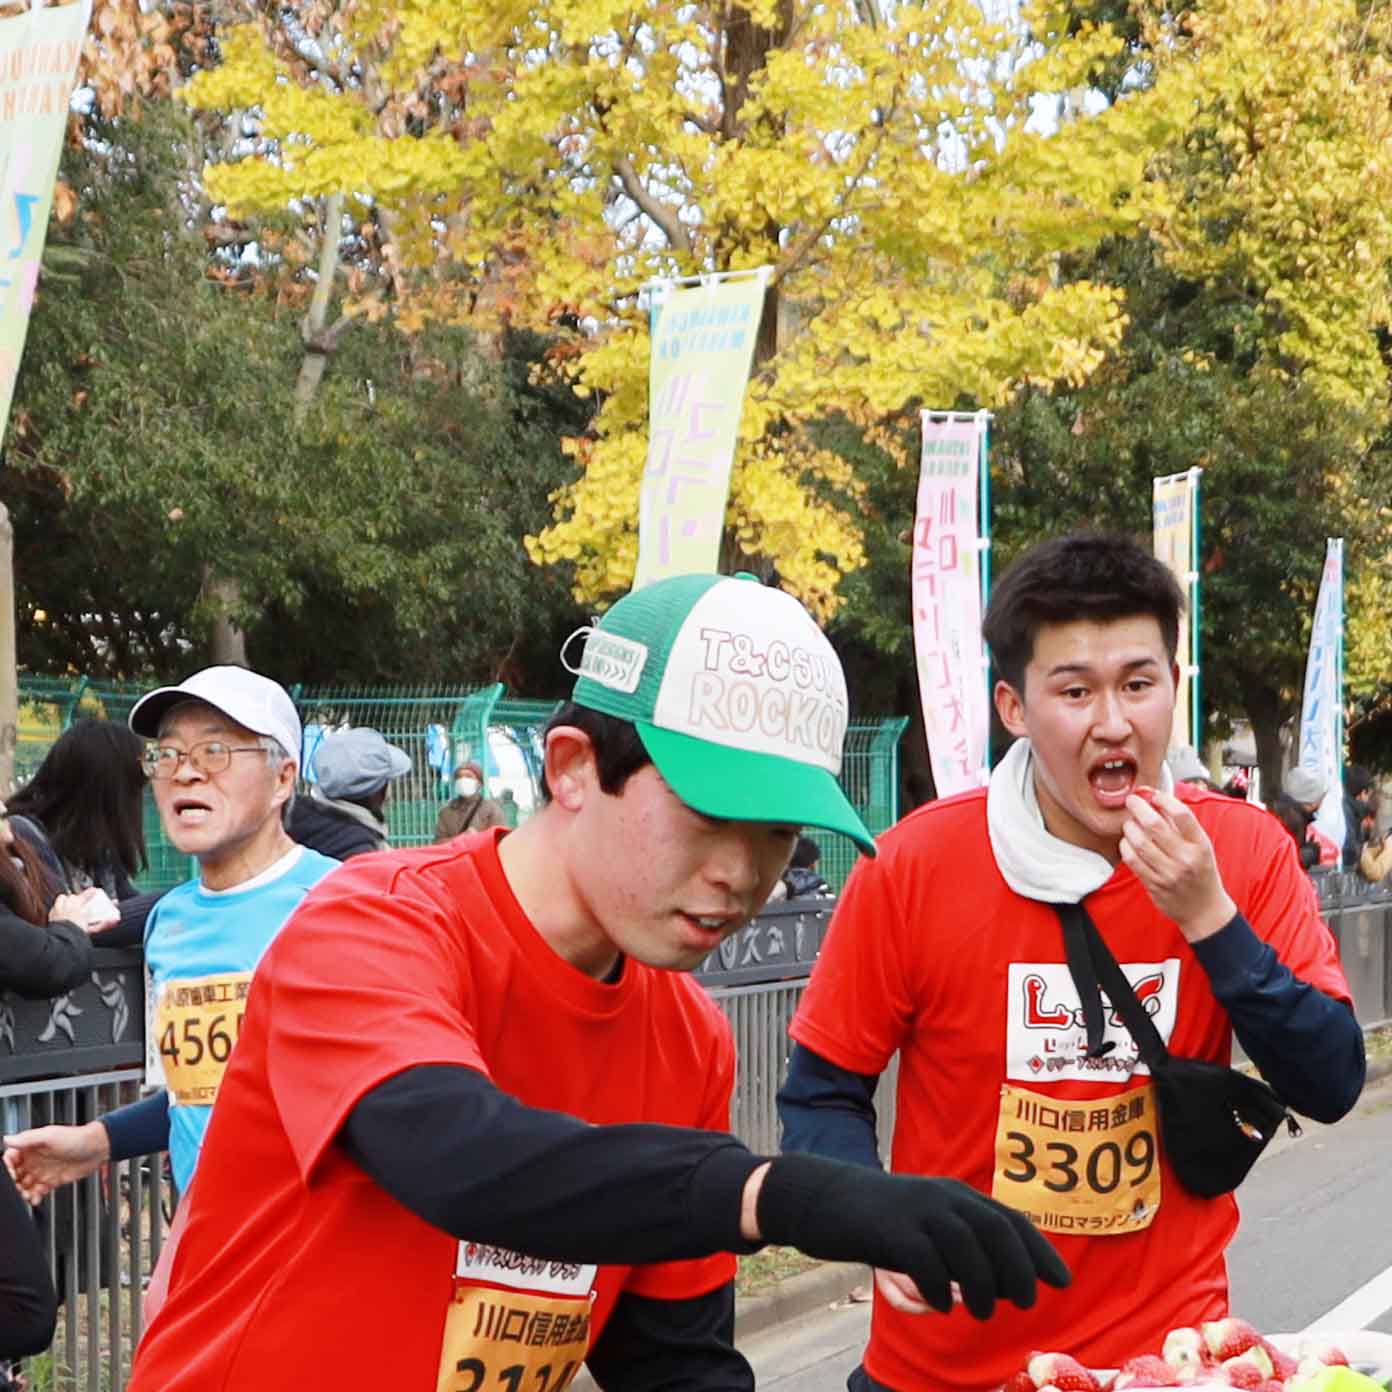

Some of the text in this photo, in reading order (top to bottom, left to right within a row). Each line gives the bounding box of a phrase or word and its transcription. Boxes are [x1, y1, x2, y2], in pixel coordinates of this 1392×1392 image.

[160, 1013, 245, 1067] 456
[1016, 1096, 1144, 1132] 川口信用金庫
[1003, 1130, 1154, 1193] 3309
